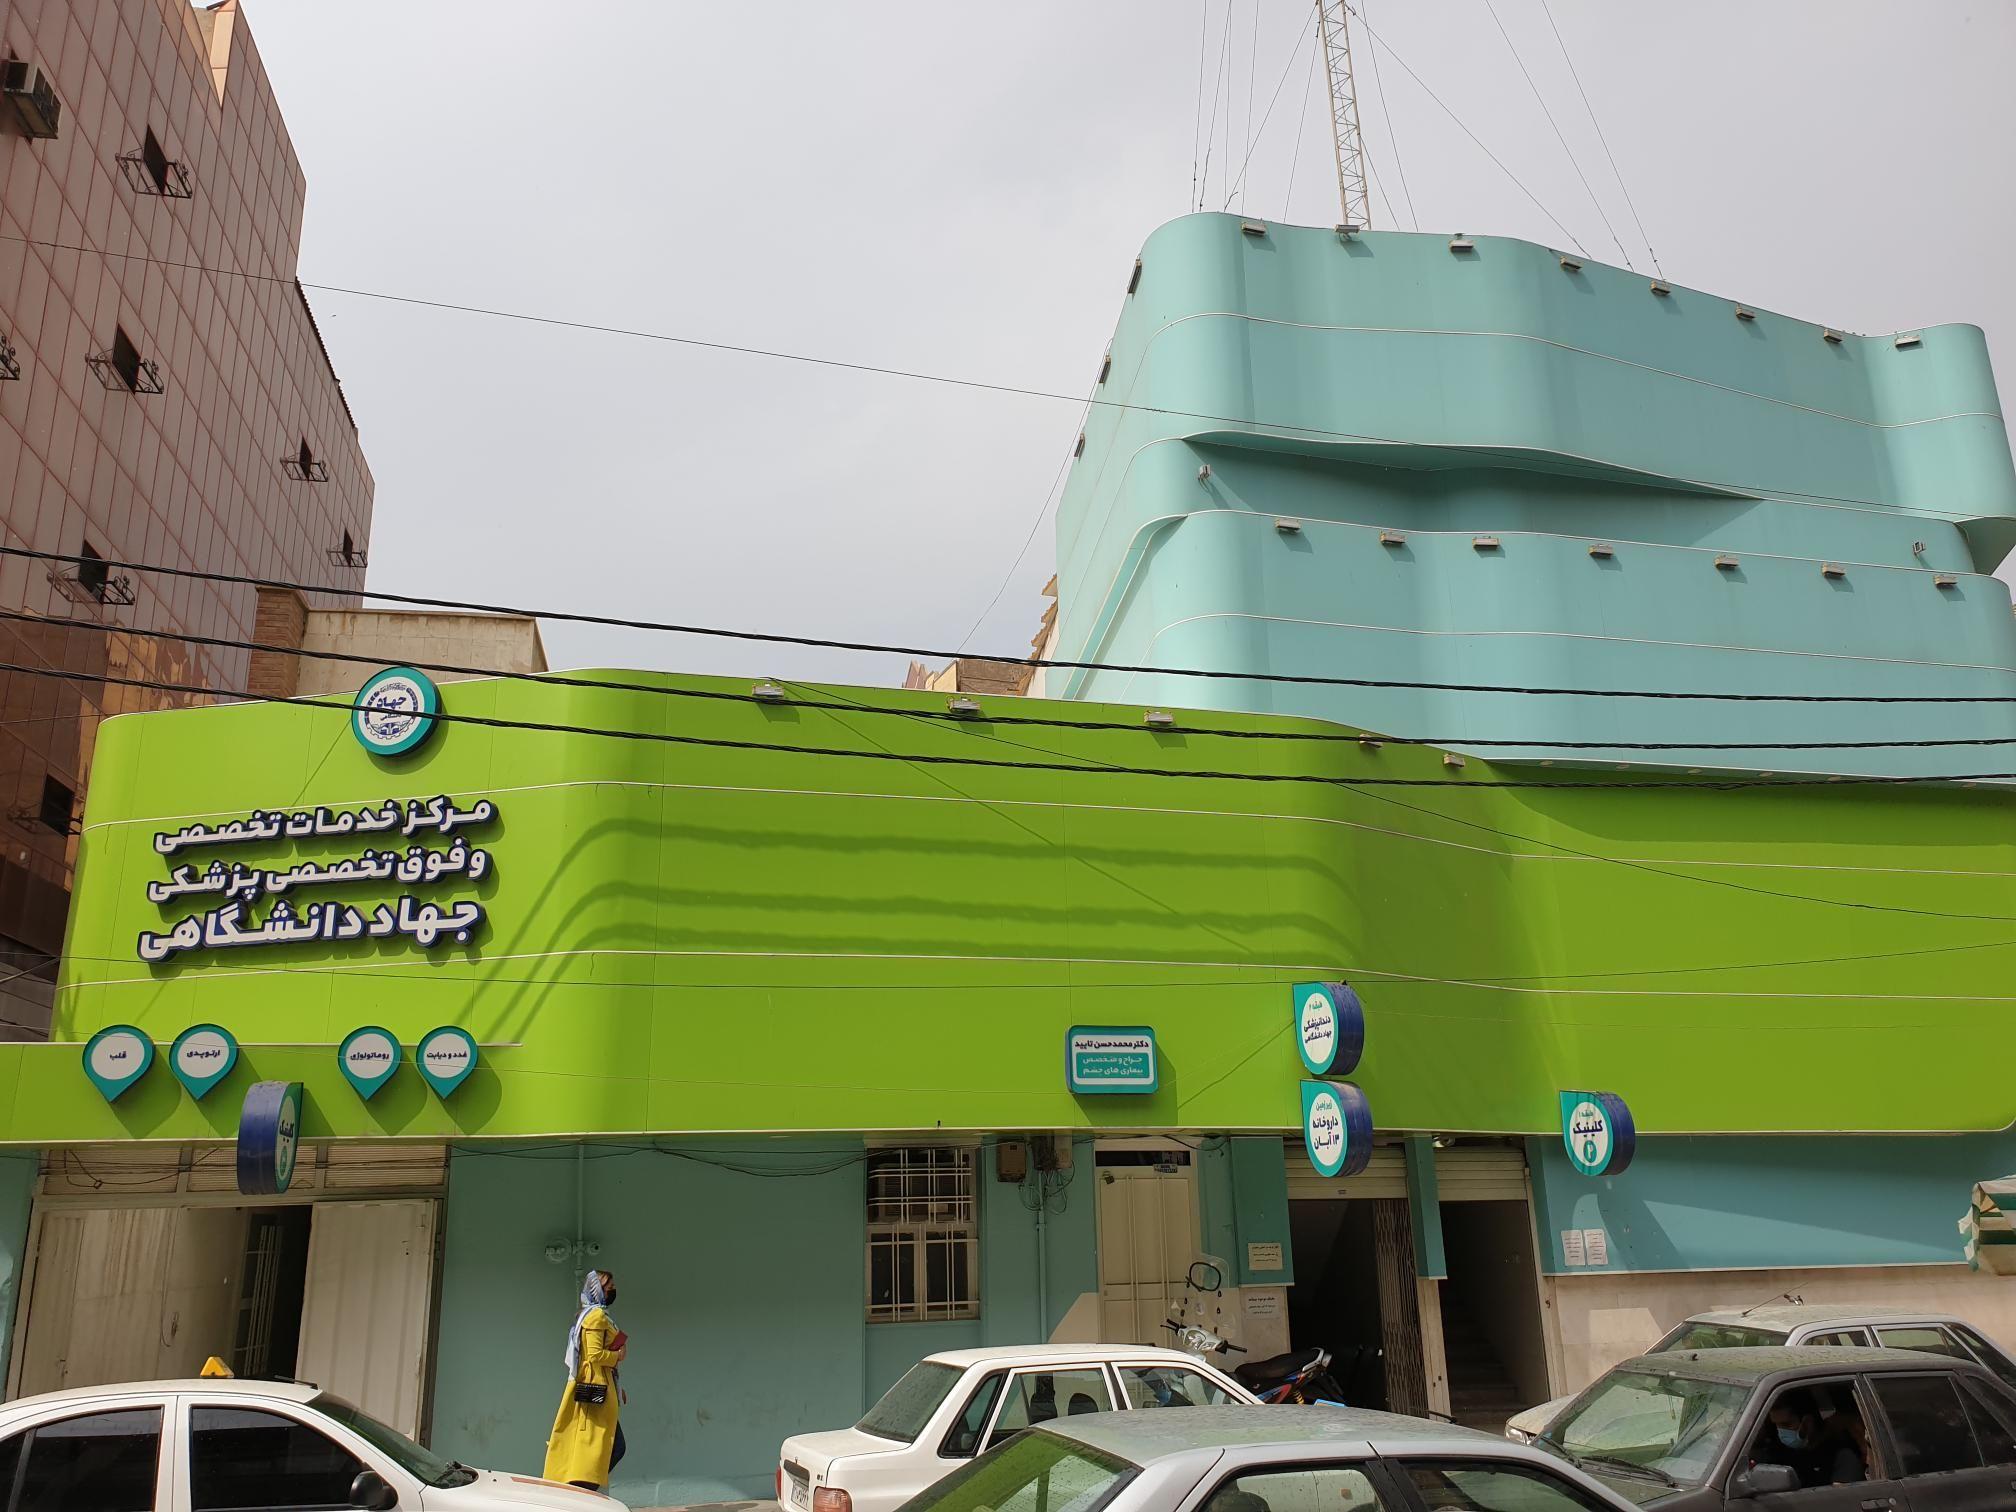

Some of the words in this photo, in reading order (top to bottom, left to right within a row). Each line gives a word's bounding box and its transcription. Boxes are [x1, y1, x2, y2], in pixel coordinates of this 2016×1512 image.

[286, 798, 402, 838] خدمات
[401, 795, 495, 837] مرکز
[153, 809, 285, 854] تخصصی
[396, 836, 470, 883] فوق
[467, 847, 492, 880] و
[265, 848, 397, 894] تخصصی
[147, 860, 264, 904] پزشکی
[138, 898, 366, 962] دانشگاهی
[367, 895, 487, 947] جهاد
[1094, 1041, 1112, 1049] حسن
[1111, 1040, 1133, 1048] محمد
[1132, 1040, 1149, 1049] دکتر
[109, 1050, 127, 1061] قلب
[186, 1049, 221, 1060] ارتوپدی
[350, 1051, 390, 1061] روماتولوژی
[426, 1050, 447, 1059] دیابت
[1123, 1056, 1143, 1066] جراح
[1312, 1115, 1339, 1131] داروخانه
[1572, 1119, 1603, 1137] کلینیک
[1314, 1131, 1332, 1150] آبان
